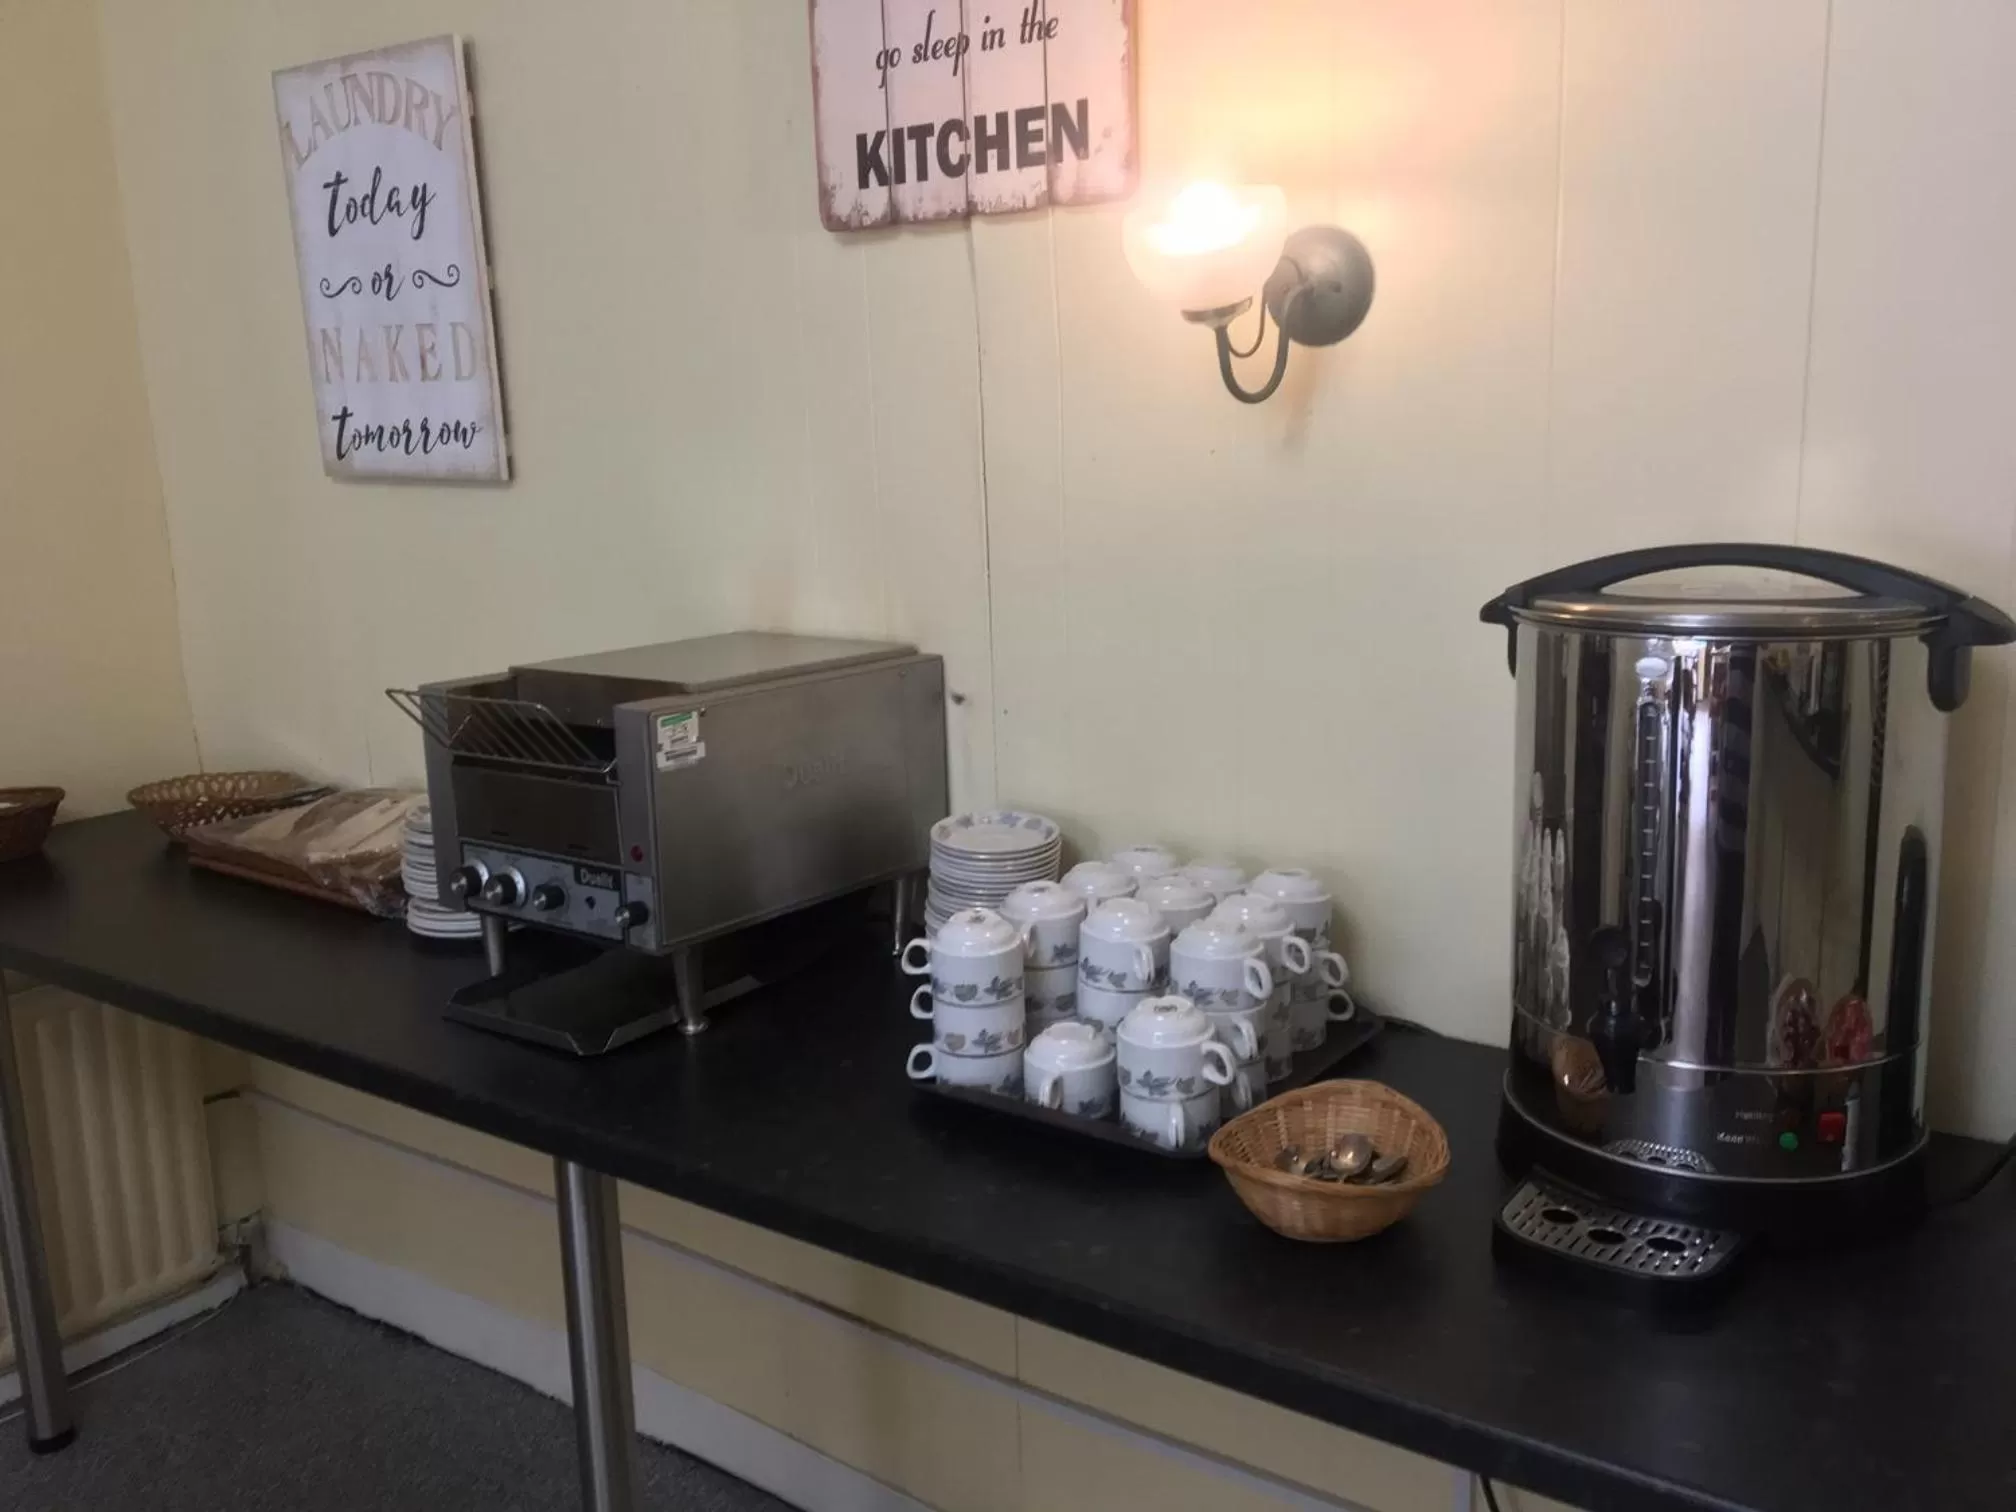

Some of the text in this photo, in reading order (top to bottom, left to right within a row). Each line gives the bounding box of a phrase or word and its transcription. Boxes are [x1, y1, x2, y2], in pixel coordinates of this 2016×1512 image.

[875, 0, 1059, 89] go sleep in the
[279, 70, 459, 169] LAUNDRY
[855, 97, 1089, 190] KITCHEN
[322, 165, 436, 240] today
[371, 263, 404, 301] or
[319, 321, 478, 385] NAKED
[331, 405, 484, 461] tomorrow
